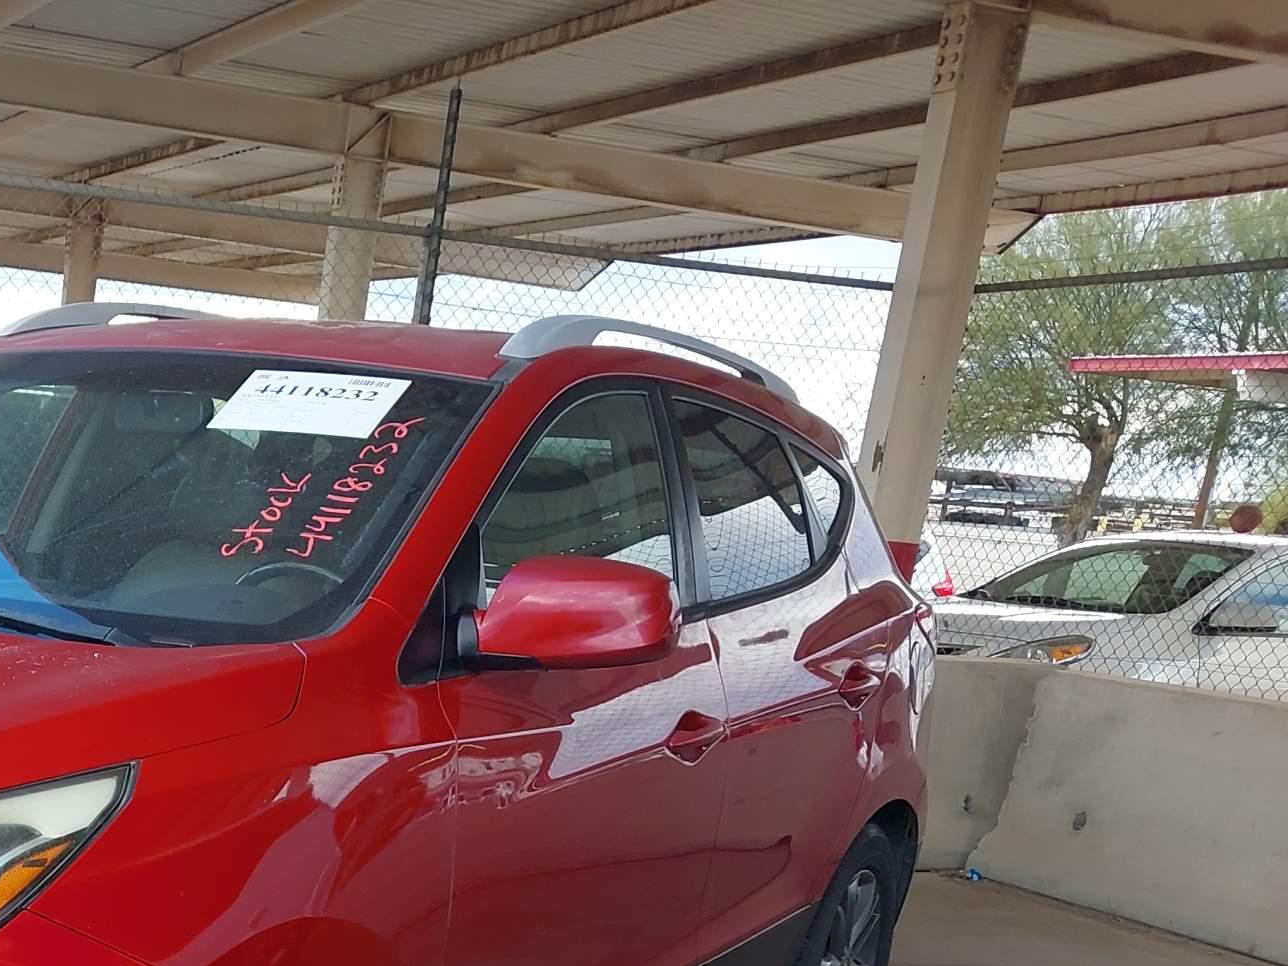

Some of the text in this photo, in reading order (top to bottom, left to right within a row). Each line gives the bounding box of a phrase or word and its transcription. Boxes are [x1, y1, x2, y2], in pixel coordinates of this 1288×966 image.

[255, 383, 379, 402] 44118232
[220, 472, 312, 557] Stock
[286, 417, 427, 557] 44118232
